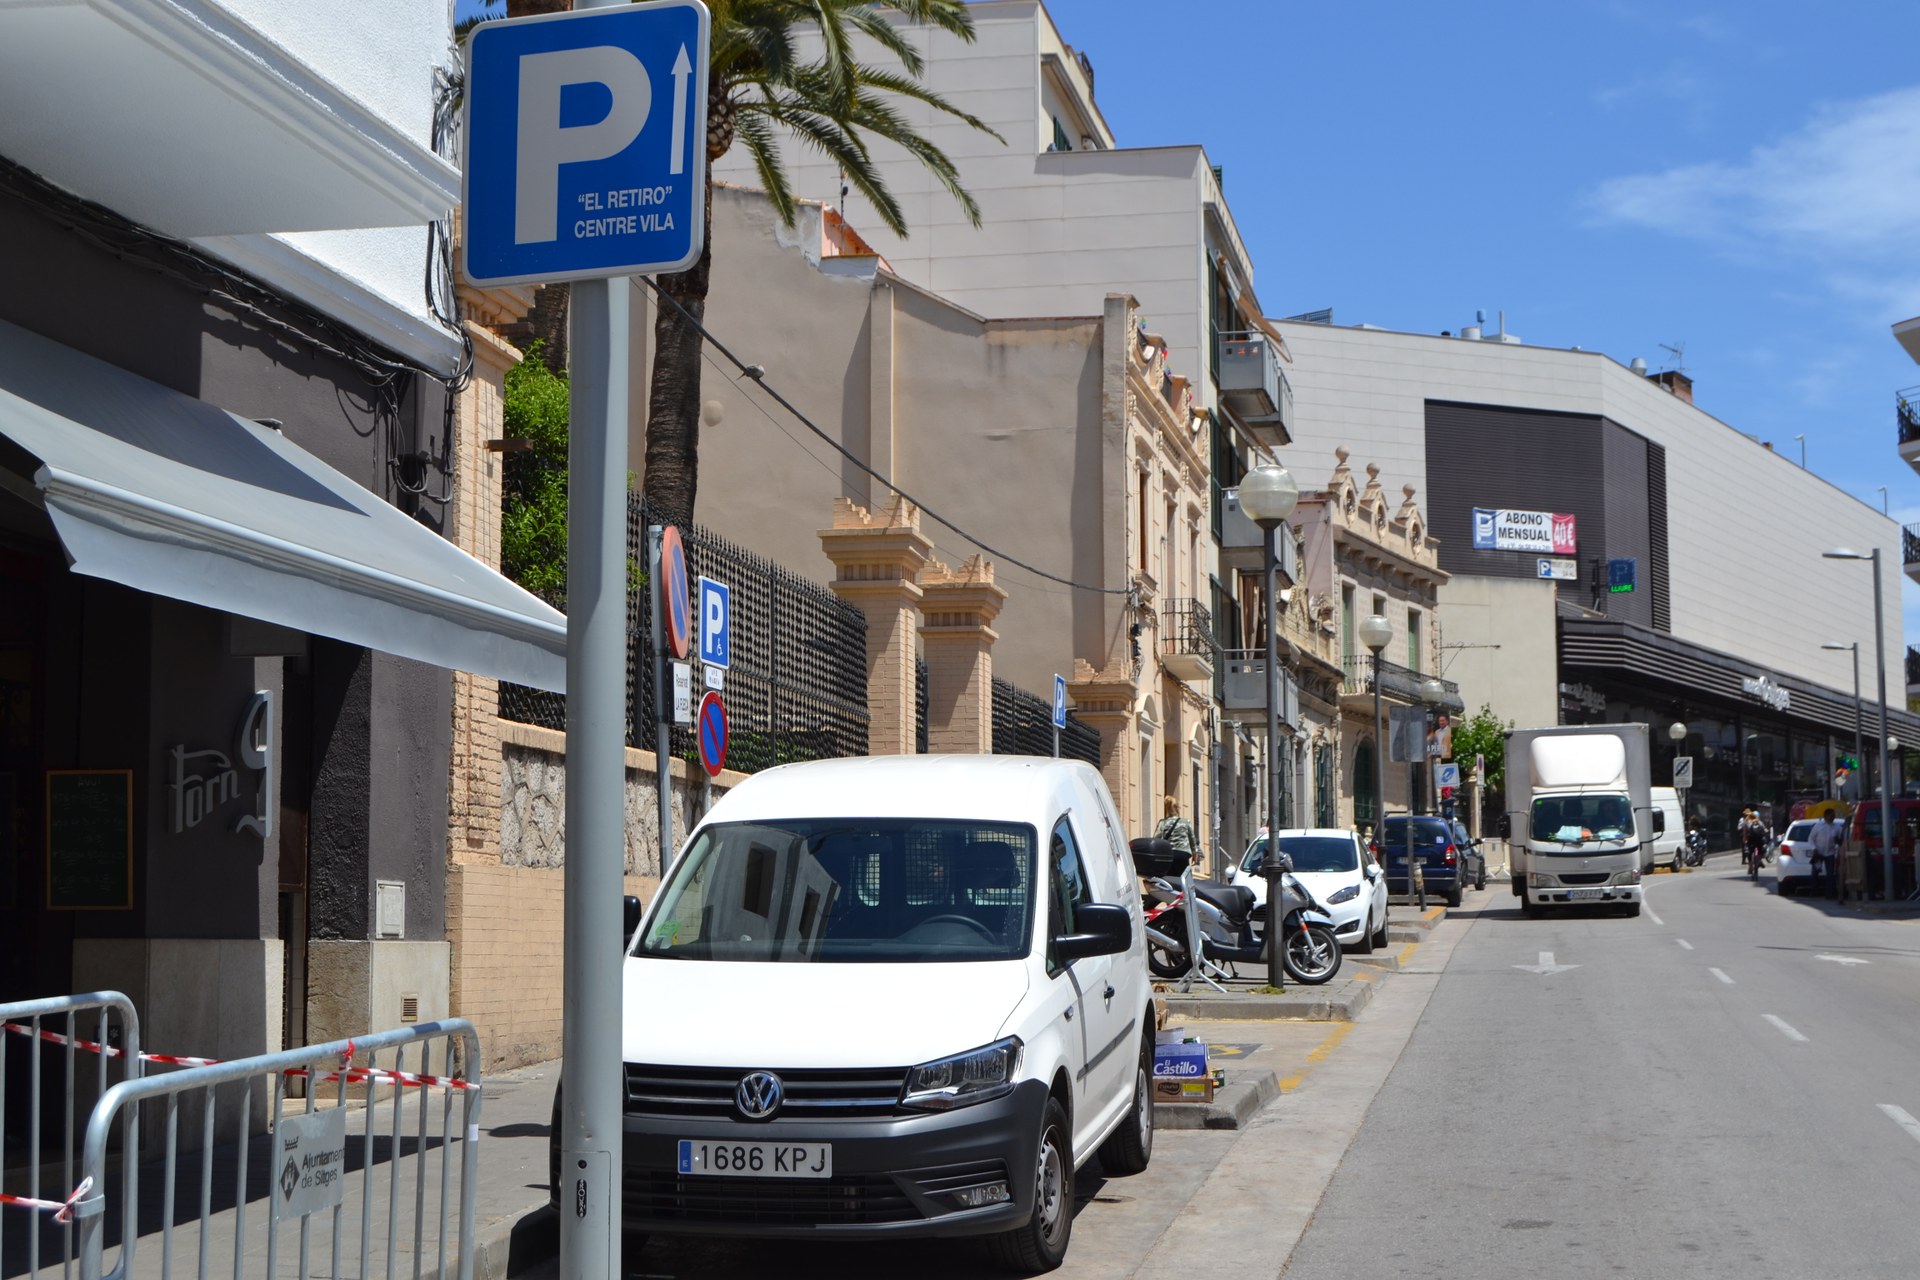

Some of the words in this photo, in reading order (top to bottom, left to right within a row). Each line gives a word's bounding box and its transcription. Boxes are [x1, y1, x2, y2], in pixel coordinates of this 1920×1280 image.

[515, 45, 652, 245] P
[574, 217, 637, 239] CENTRE
[640, 212, 675, 233] VILA
[1506, 513, 1543, 525] ABONO
[1498, 527, 1551, 541] MENSUAL
[1540, 562, 1550, 575] P
[706, 590, 723, 653] P
[1056, 681, 1063, 720] P
[1154, 1061, 1197, 1075] Castillo
[701, 1145, 763, 1172] 1686
[775, 1147, 826, 1173] KPJ
[302, 1174, 313, 1189] de
[315, 1168, 338, 1187] Sitges
